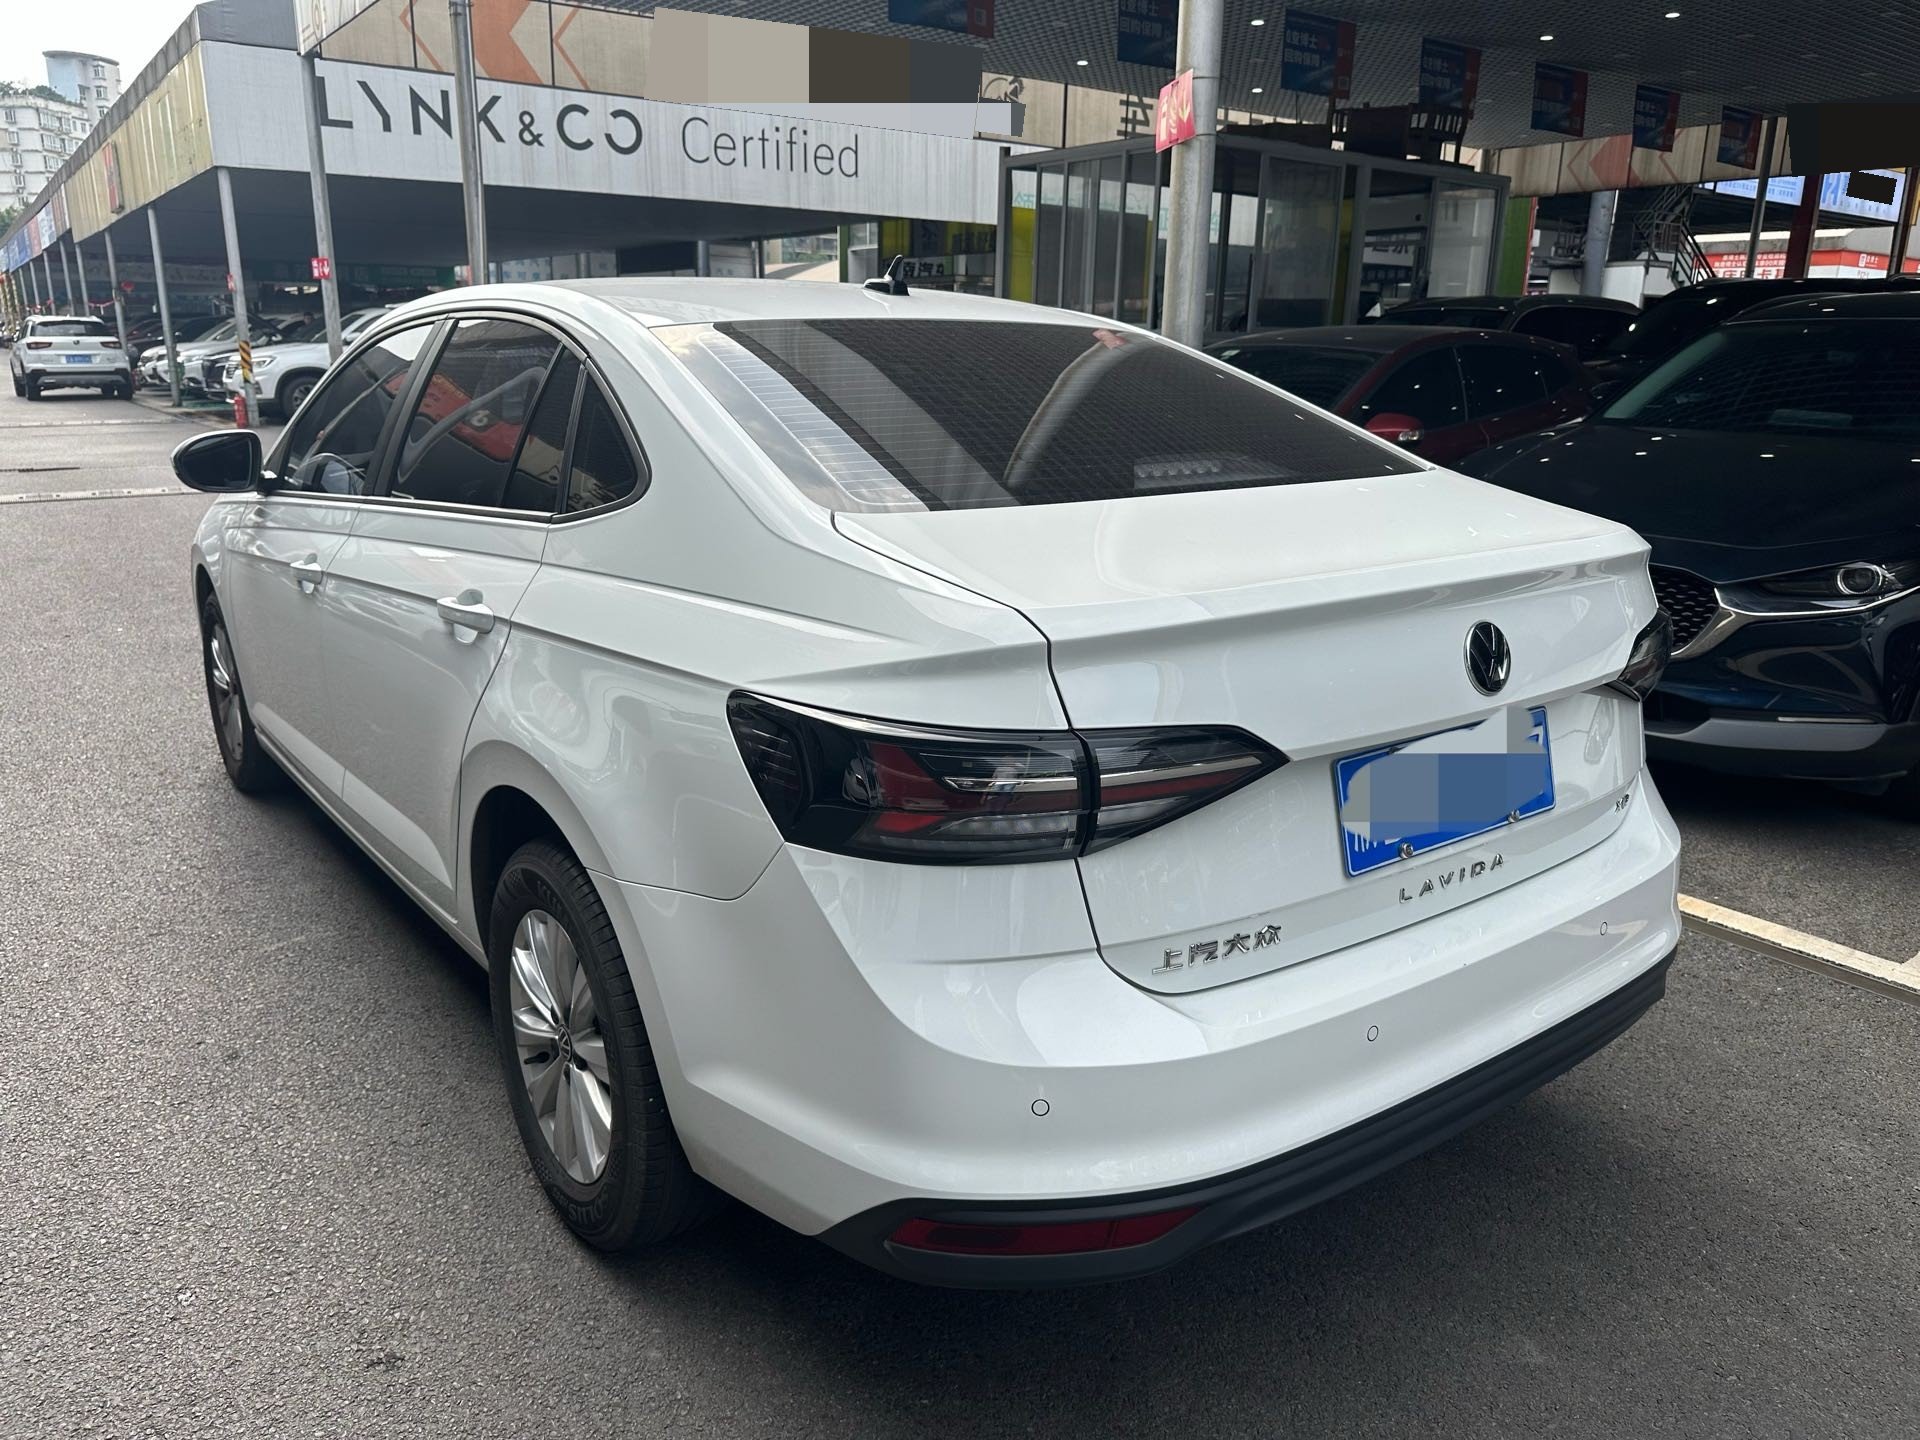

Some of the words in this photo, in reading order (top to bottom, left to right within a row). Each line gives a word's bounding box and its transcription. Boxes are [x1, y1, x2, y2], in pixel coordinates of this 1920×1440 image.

[681, 116, 860, 178] Certified
[1398, 853, 1505, 904] LAVIDA
[1152, 924, 1282, 975] 上汽大众
